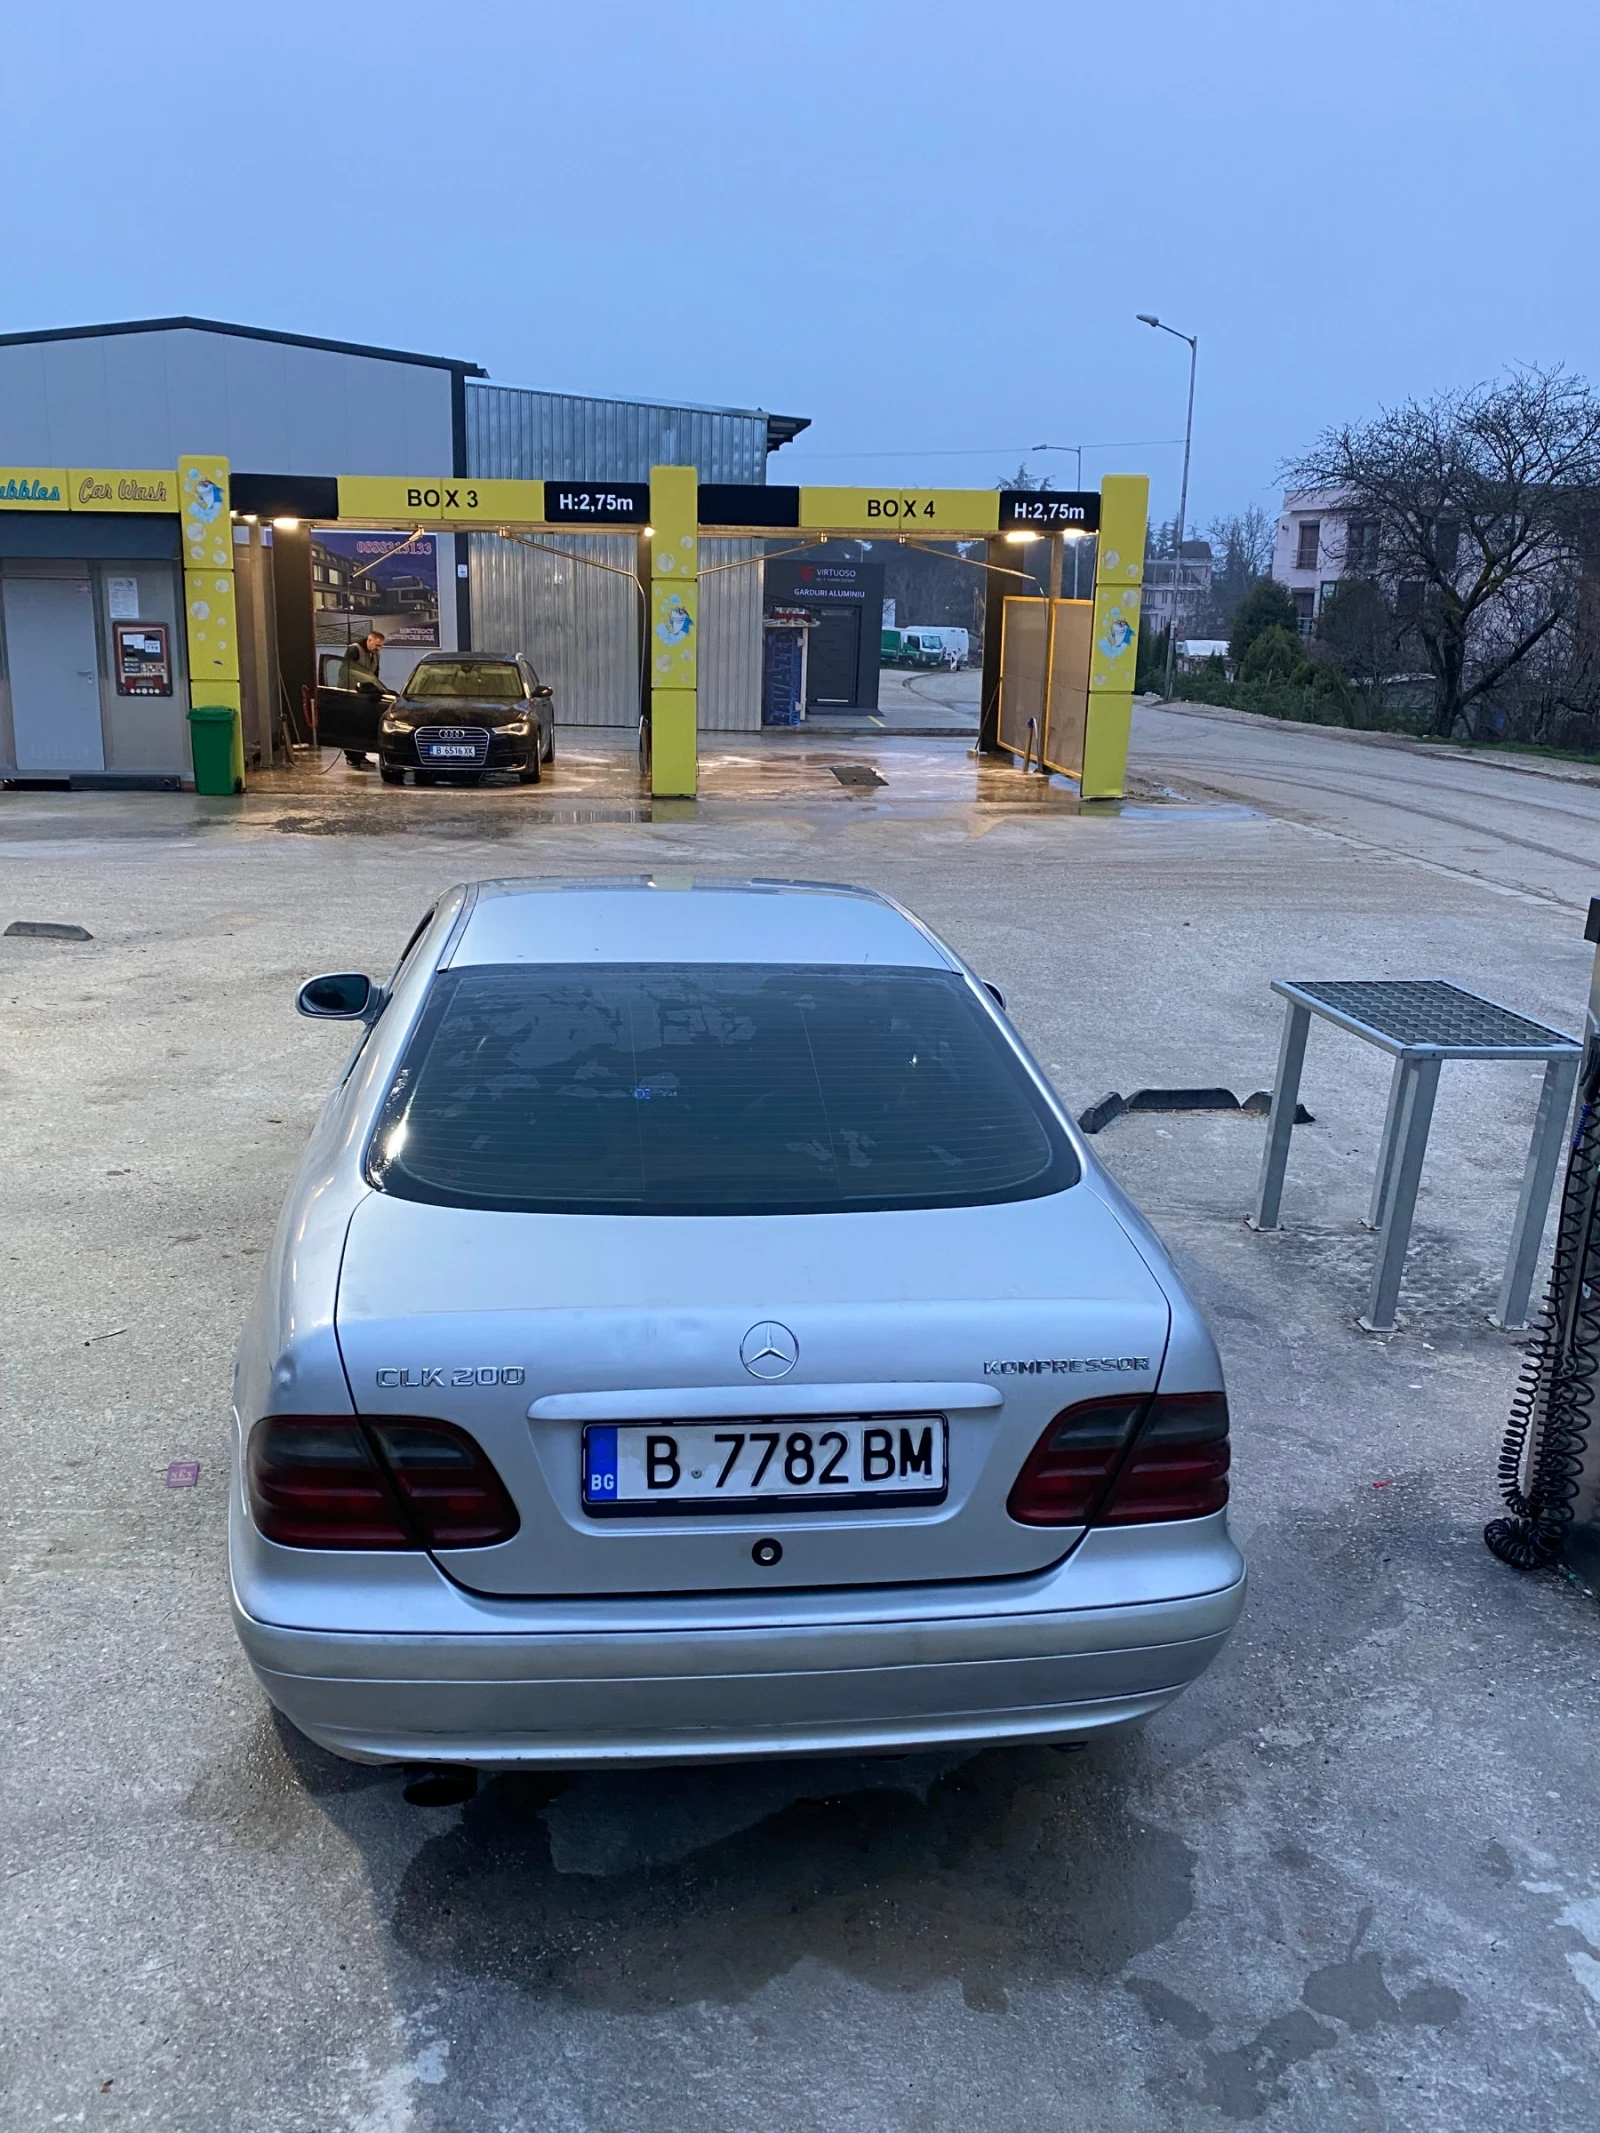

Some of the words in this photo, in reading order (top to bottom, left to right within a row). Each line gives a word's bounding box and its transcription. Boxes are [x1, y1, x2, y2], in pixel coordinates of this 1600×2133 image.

[79, 477, 112, 503] Car
[118, 479, 167, 502] Wash
[407, 489, 460, 507] BOX
[467, 491, 479, 508] 3
[559, 494, 634, 512] H:2,75m
[867, 500, 917, 518] BOX
[923, 501, 936, 518] 4
[1014, 503, 1086, 521] H:2,75m
[816, 568, 857, 578] VIRTUOSO
[794, 588, 828, 597] GARDURI
[828, 590, 866, 599] ALUMINIU
[983, 1355, 1150, 1376] KOMPRESSOR
[376, 1367, 446, 1388] CLK
[451, 1366, 526, 1388] 200
[646, 1435, 681, 1491] B
[714, 1430, 850, 1489] 7782
[862, 1427, 933, 1483] BM
[591, 1473, 615, 1491] BG
